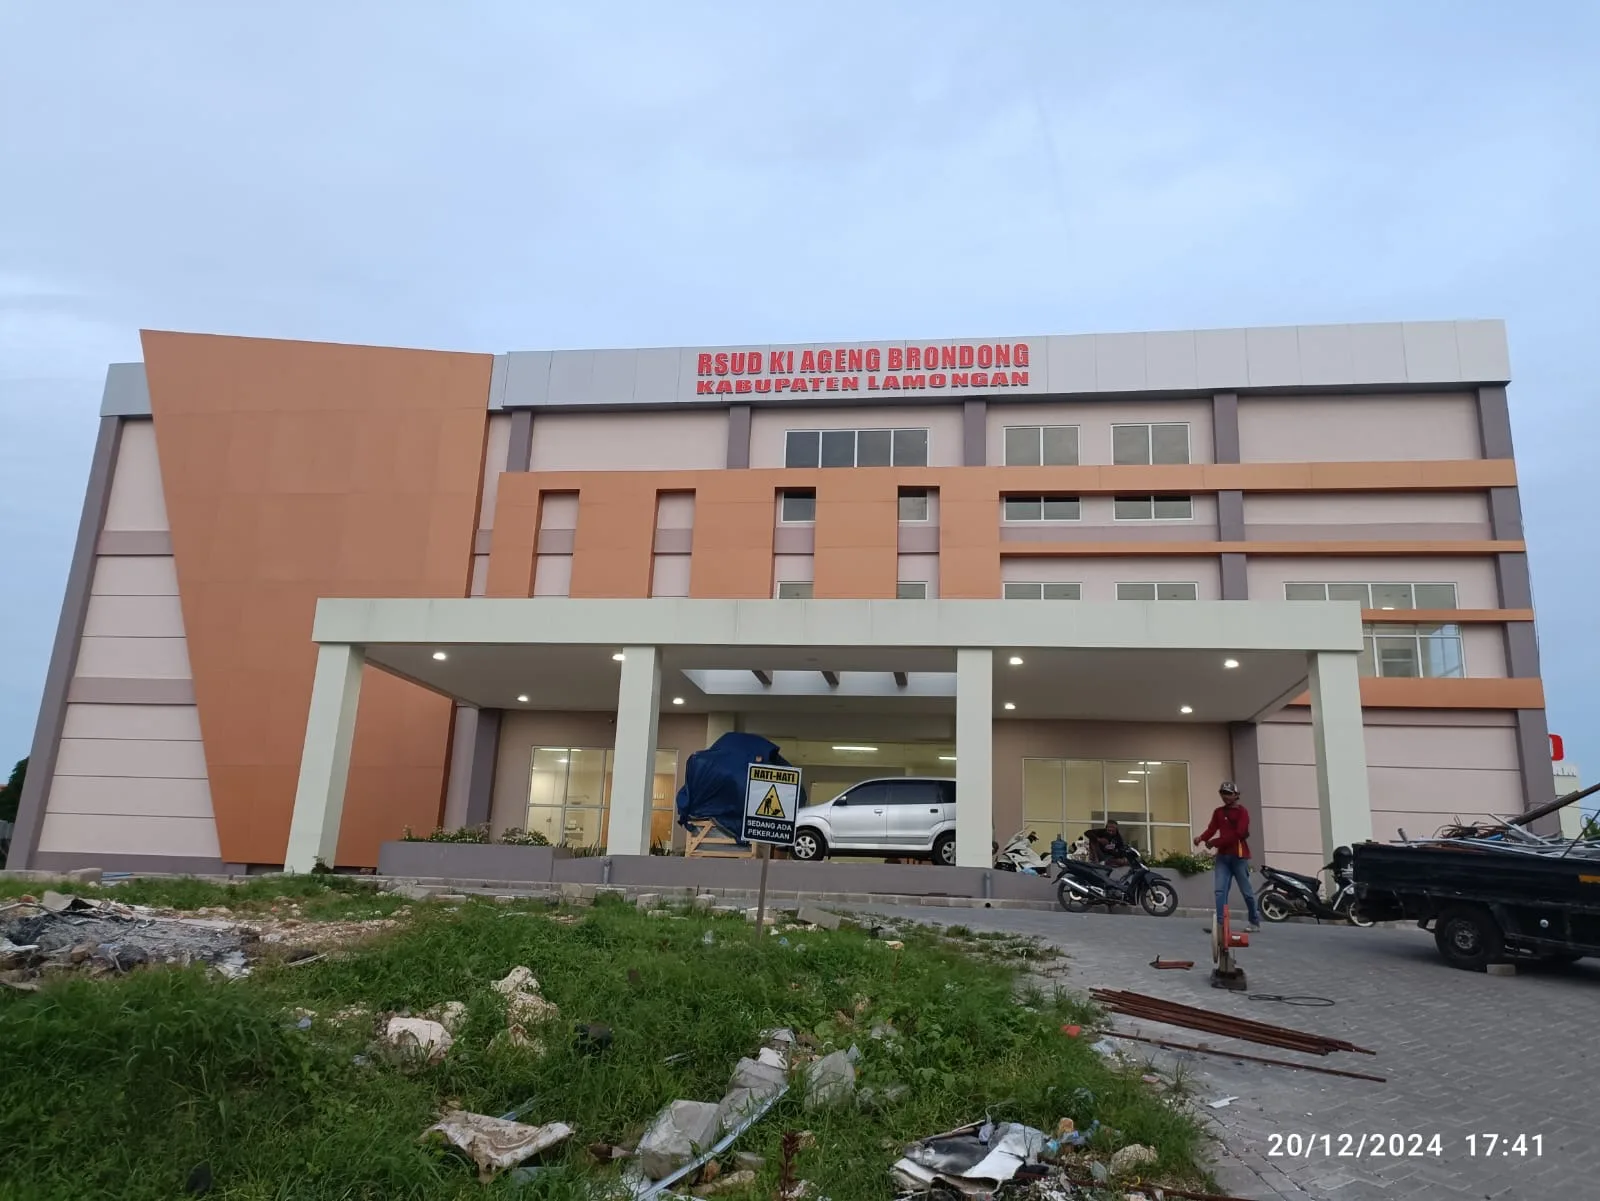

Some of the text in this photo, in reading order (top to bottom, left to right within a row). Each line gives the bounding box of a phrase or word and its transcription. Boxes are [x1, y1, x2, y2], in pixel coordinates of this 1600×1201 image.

[697, 343, 1030, 376] RSUD KI AGENG BRONDONG
[696, 371, 1029, 395] KABUPATEN LAMONGAN
[754, 769, 795, 782] HATI-HATI
[747, 820, 776, 829] SEDANG
[748, 829, 790, 840] PEKERJAAN
